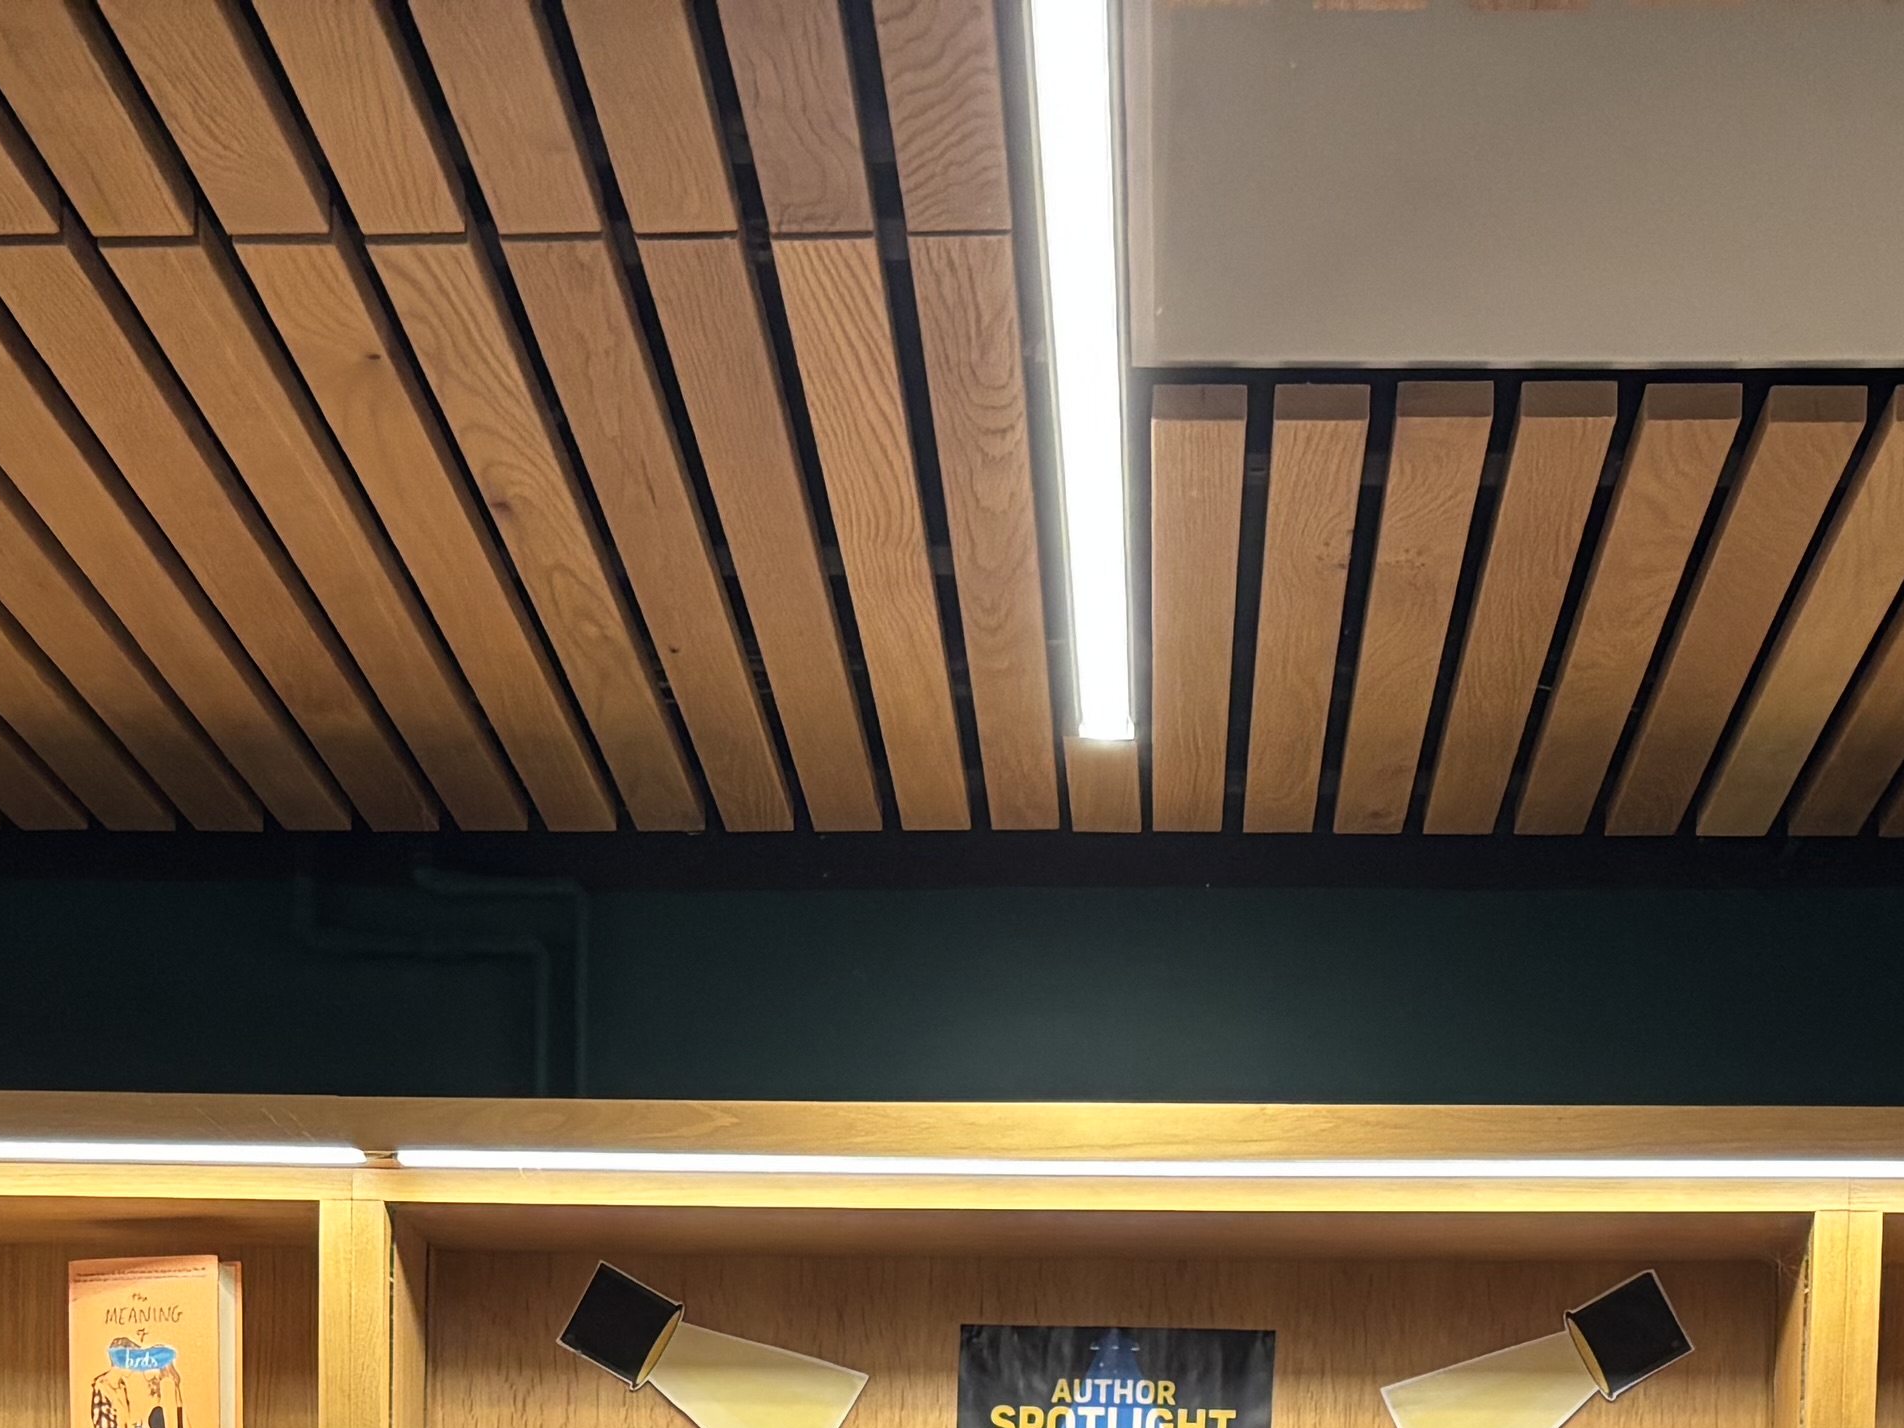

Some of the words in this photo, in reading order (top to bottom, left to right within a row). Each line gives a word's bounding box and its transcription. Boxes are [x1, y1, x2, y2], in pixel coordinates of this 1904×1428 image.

[132, 1293, 147, 1301] the
[105, 1305, 183, 1325] MEANING
[1051, 1378, 1177, 1406] AUTHOR
